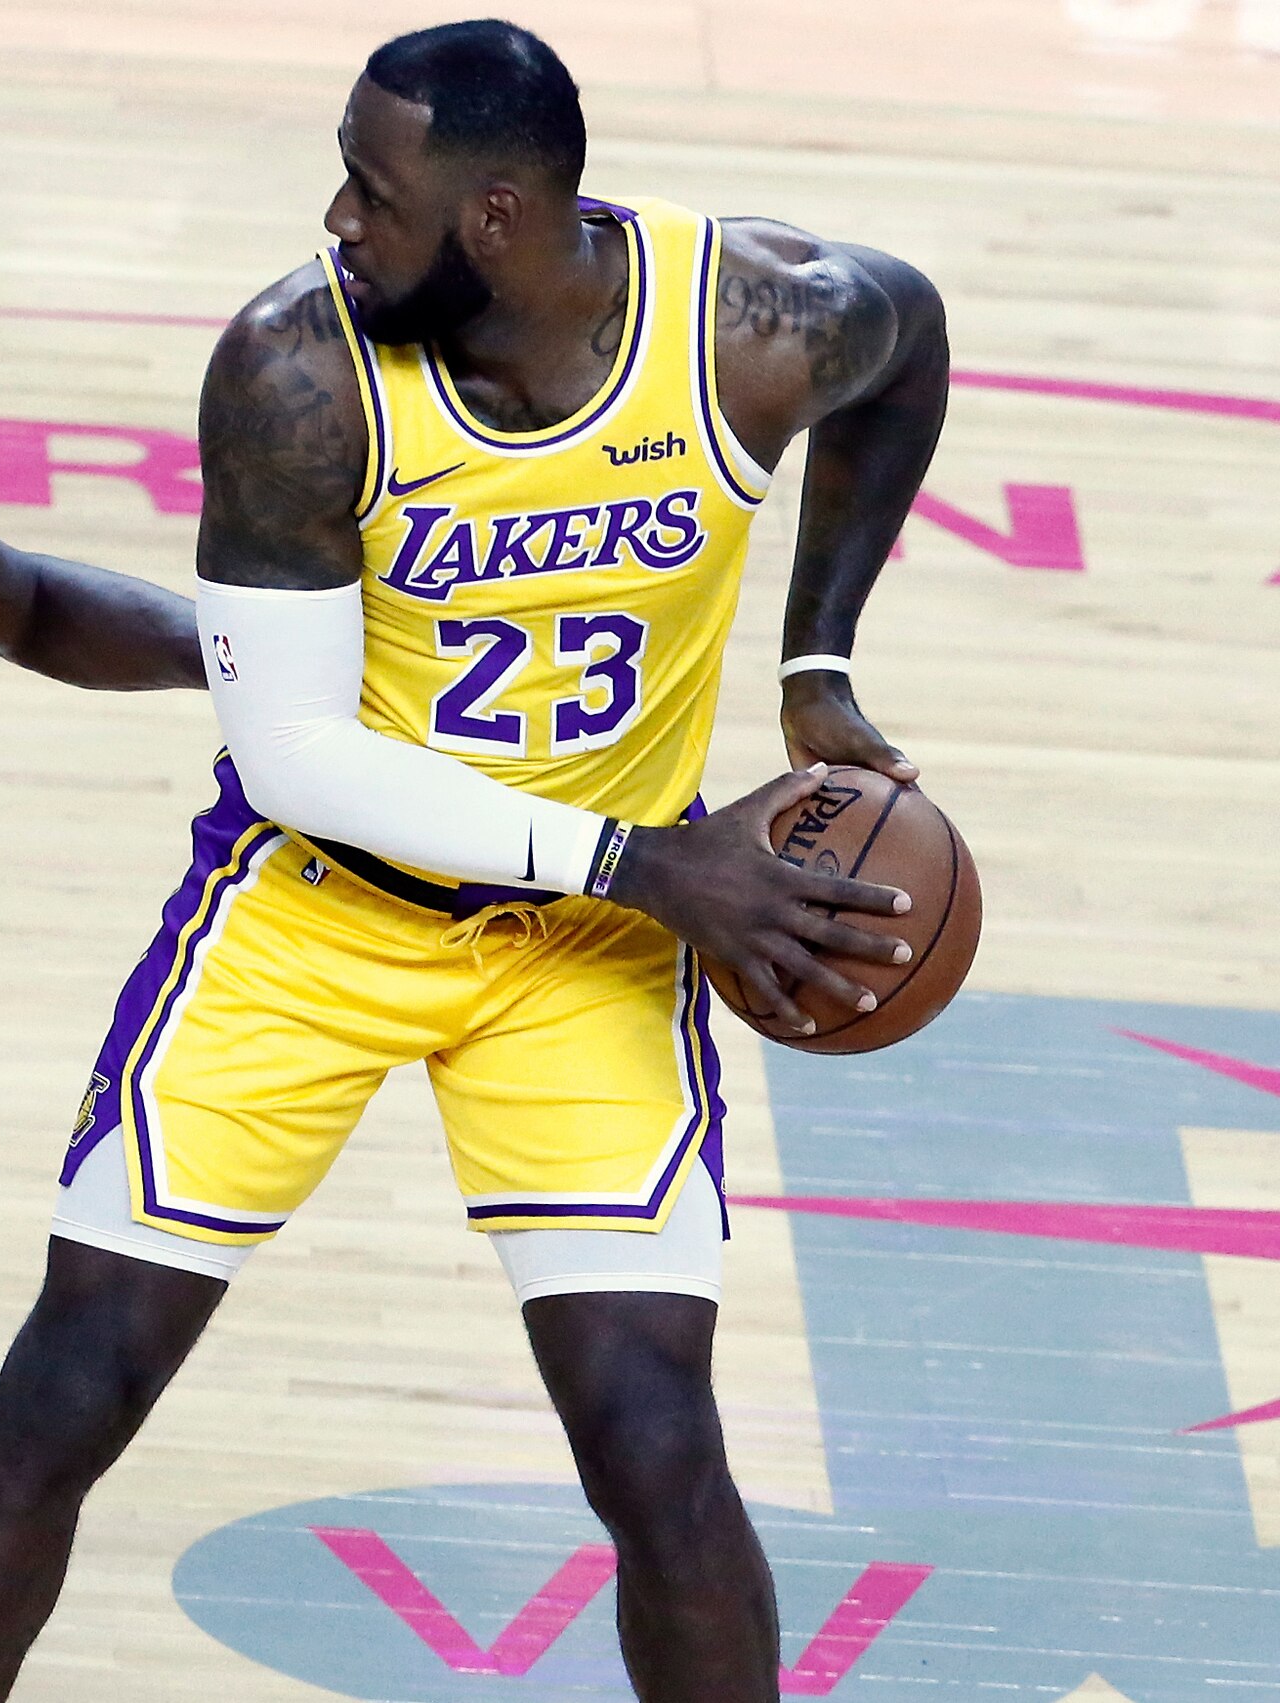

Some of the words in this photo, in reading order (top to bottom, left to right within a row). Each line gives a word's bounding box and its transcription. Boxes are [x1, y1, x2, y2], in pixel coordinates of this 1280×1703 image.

[602, 431, 687, 468] wish
[377, 489, 708, 604] LAKERS
[427, 612, 651, 759] 23
[595, 833, 625, 891] PROMISE
